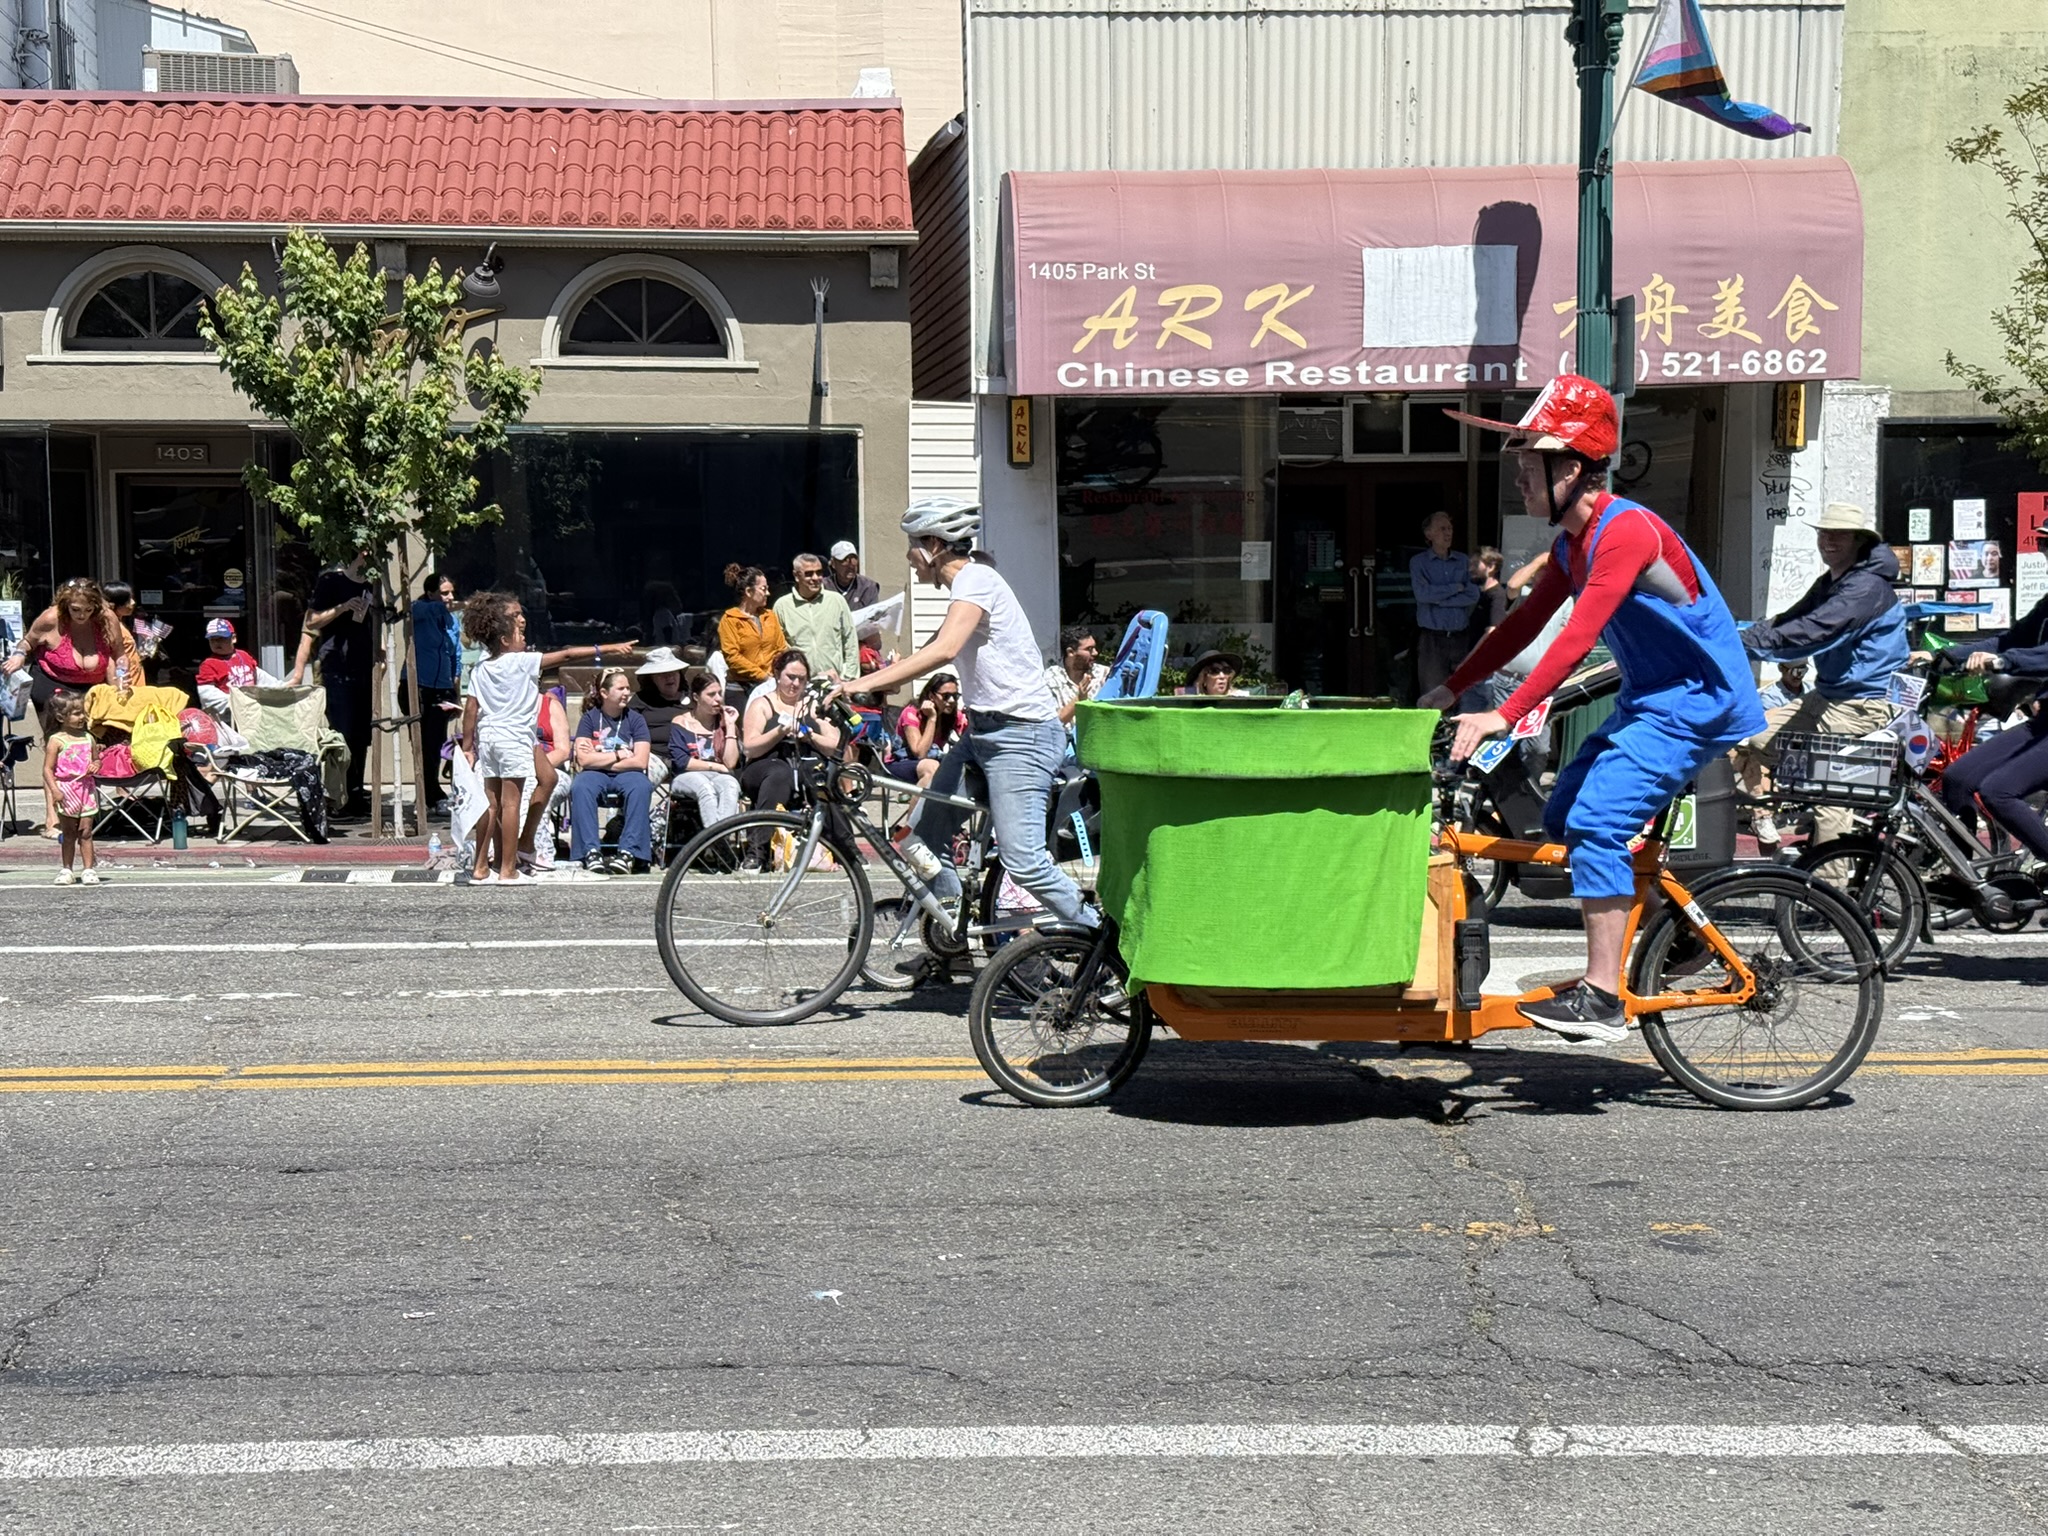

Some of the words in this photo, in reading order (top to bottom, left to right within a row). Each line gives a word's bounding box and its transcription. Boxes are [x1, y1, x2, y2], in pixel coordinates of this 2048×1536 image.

[1029, 263, 1077, 280] 1405
[1082, 263, 1129, 280] Park
[1134, 263, 1156, 280] St
[1072, 282, 1315, 354] ARK
[1056, 361, 1250, 388] Chinese
[1264, 355, 1529, 387] Restaurant
[1661, 348, 1828, 378] 521-6862
[1014, 405, 1028, 456] ARK
[157, 446, 206, 461] 1403
